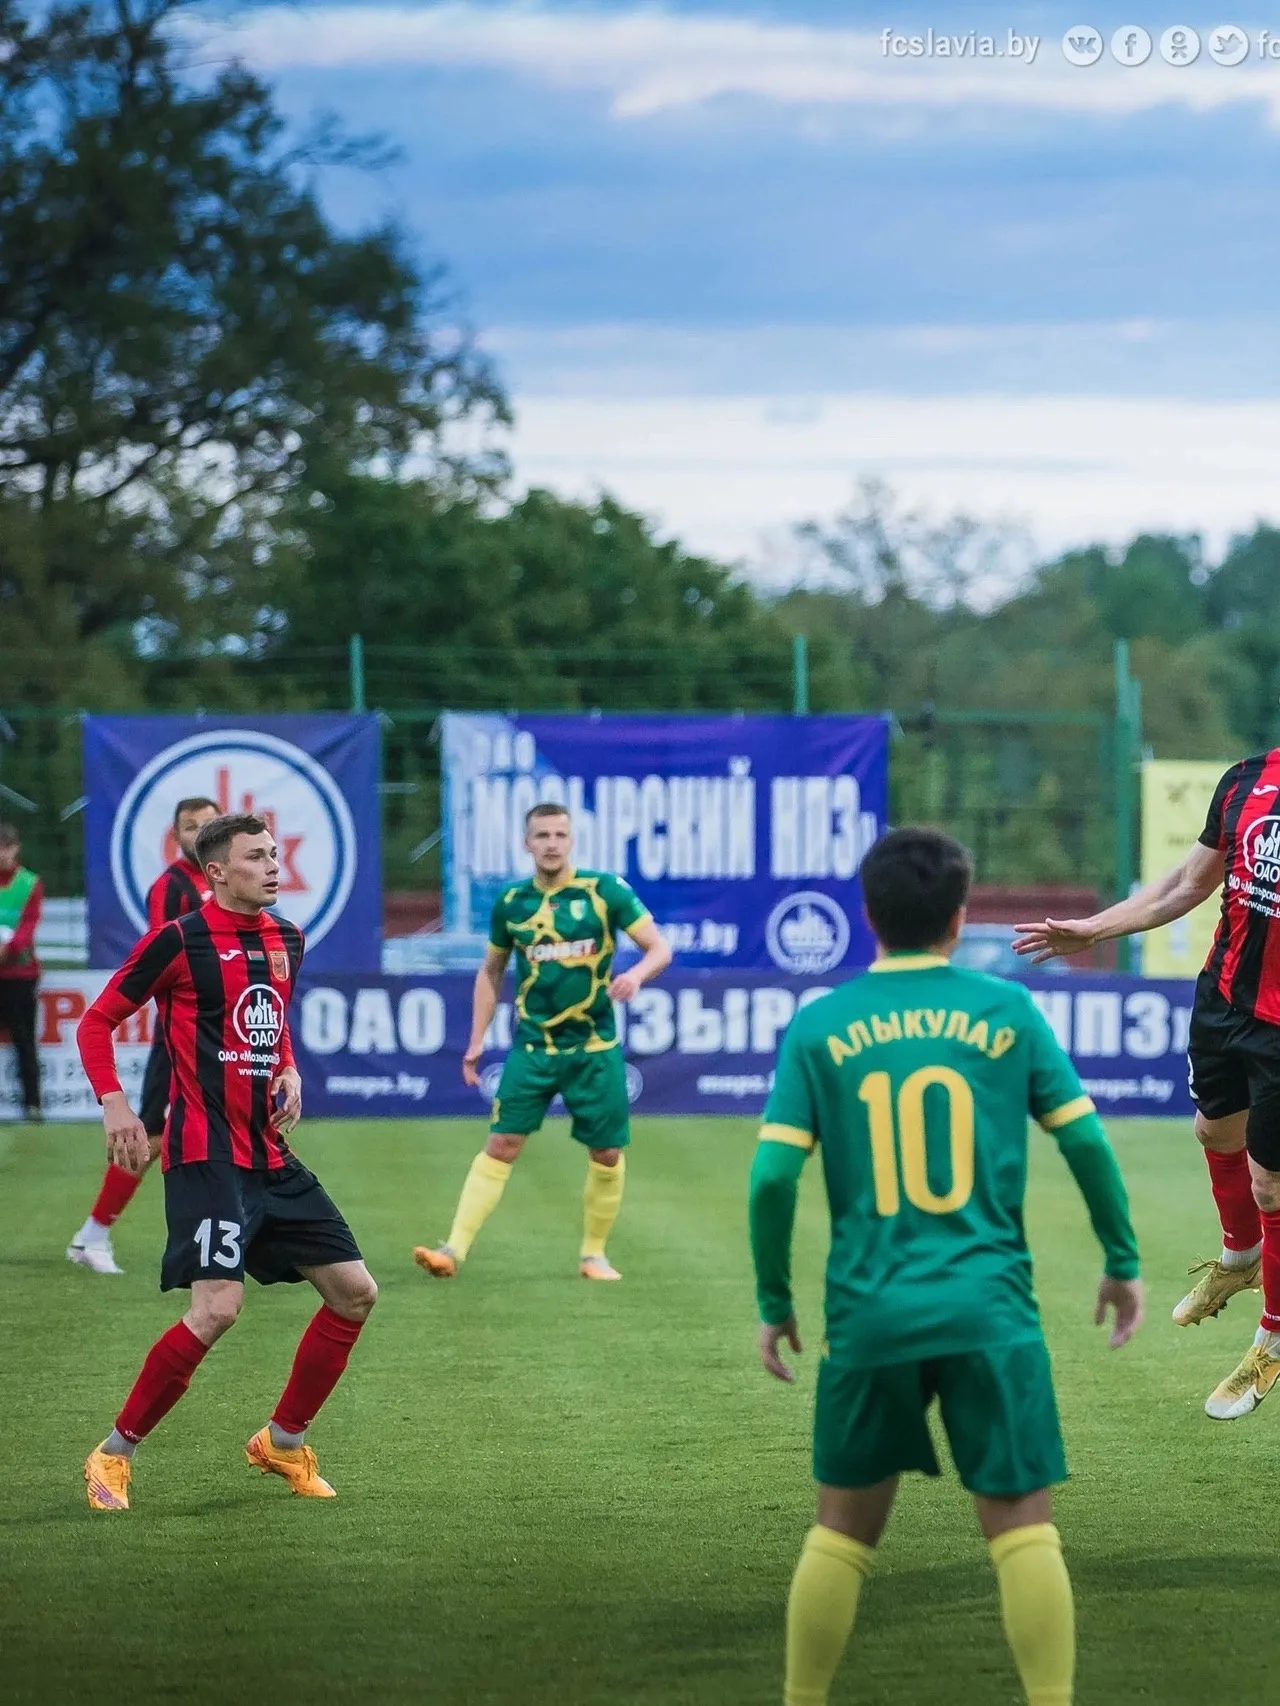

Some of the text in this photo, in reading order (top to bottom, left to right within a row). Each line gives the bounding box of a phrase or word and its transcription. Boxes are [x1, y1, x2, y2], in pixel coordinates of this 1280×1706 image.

[1253, 861, 1280, 883] ОАО
[249, 1030, 276, 1047] ОАО
[300, 986, 447, 1056] ОАО
[218, 1050, 238, 1062] ОАО
[857, 1064, 975, 1217] 10
[193, 1217, 241, 1269] 13
